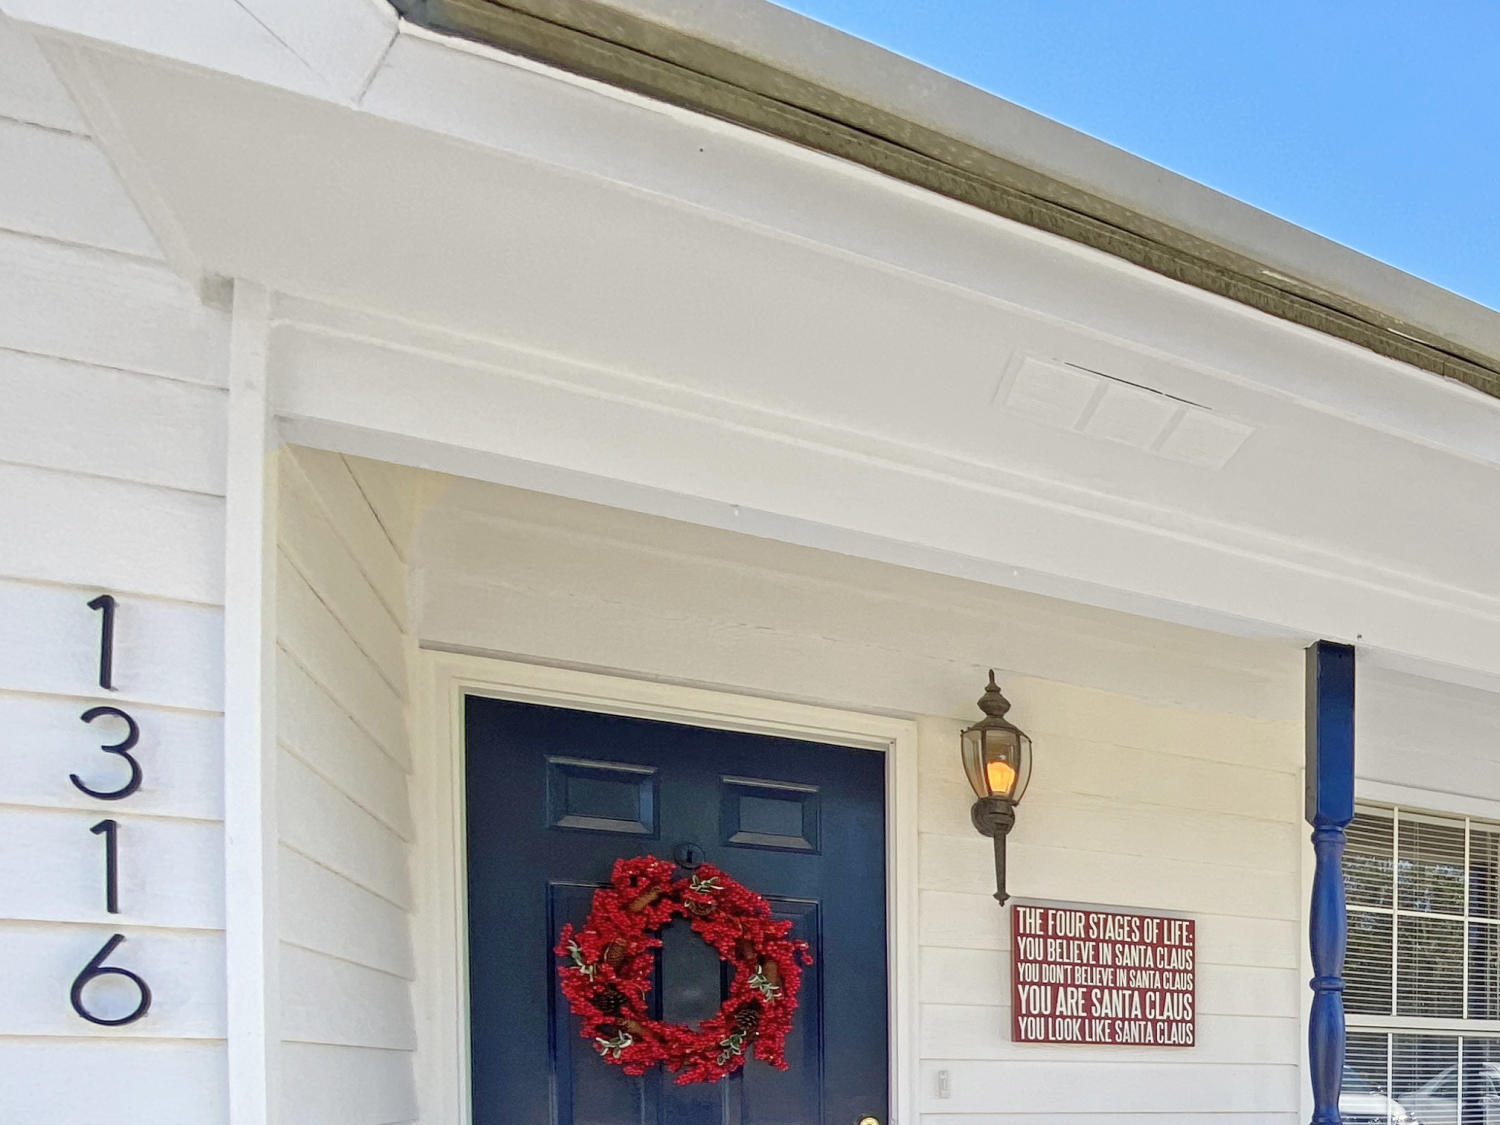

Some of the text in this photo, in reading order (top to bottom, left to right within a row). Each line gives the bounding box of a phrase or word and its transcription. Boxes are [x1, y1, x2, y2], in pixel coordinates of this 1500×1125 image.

[69, 594, 151, 1026] 1316
[1017, 907, 1193, 946] THE FOUR STAGES OF LIFE:
[1018, 937, 1193, 970] YOU BELIEVE IN SANTA CLAUS
[1018, 963, 1193, 990] YOU DON'T BELIEVE IN SANTA CLAUS
[1018, 985, 1193, 1020] YOU ARE SANTA CLAUS
[1018, 1017, 1193, 1044] YOU LOOK LIKE SANTA CLAUS
